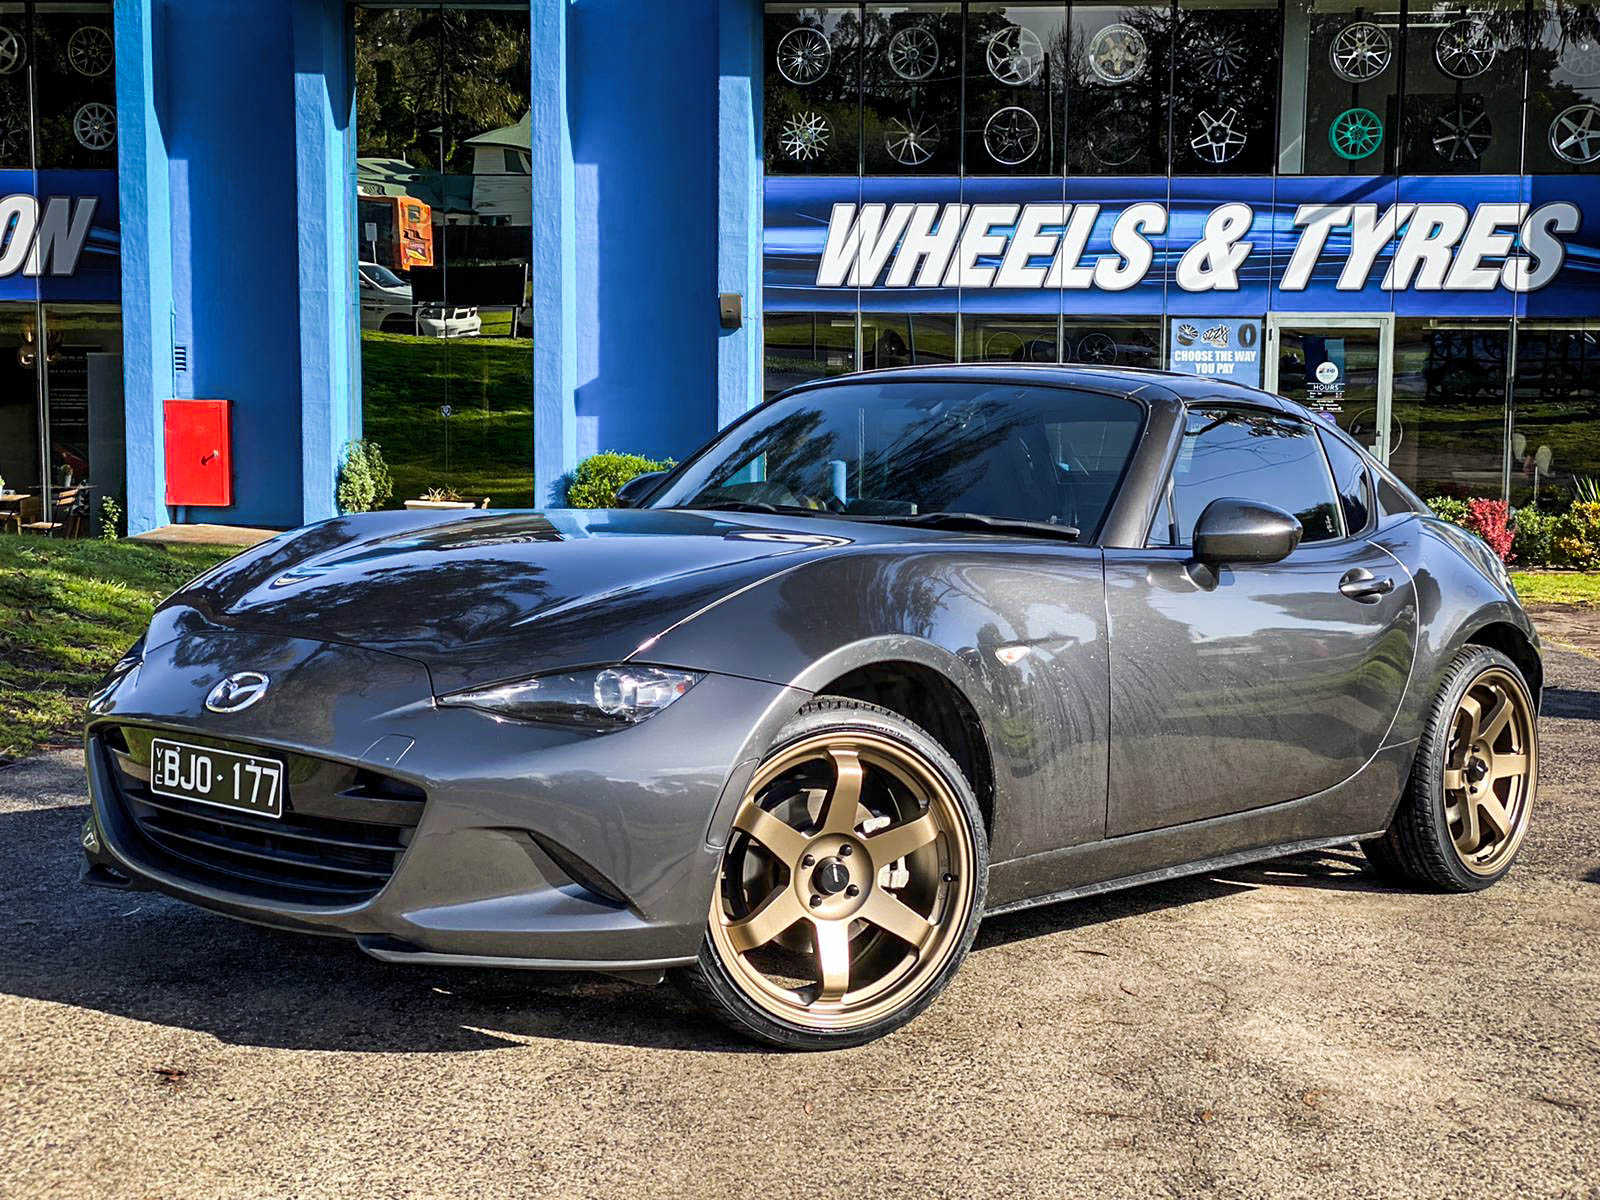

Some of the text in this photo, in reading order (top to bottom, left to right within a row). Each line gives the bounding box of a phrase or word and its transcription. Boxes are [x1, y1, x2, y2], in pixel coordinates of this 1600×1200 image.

[816, 202, 1580, 292] WHEELS & TYRES
[1174, 350, 1257, 362] CHOOSE THE WAY
[1195, 363, 1235, 374] YOU PAY
[155, 747, 163, 785] VIC
